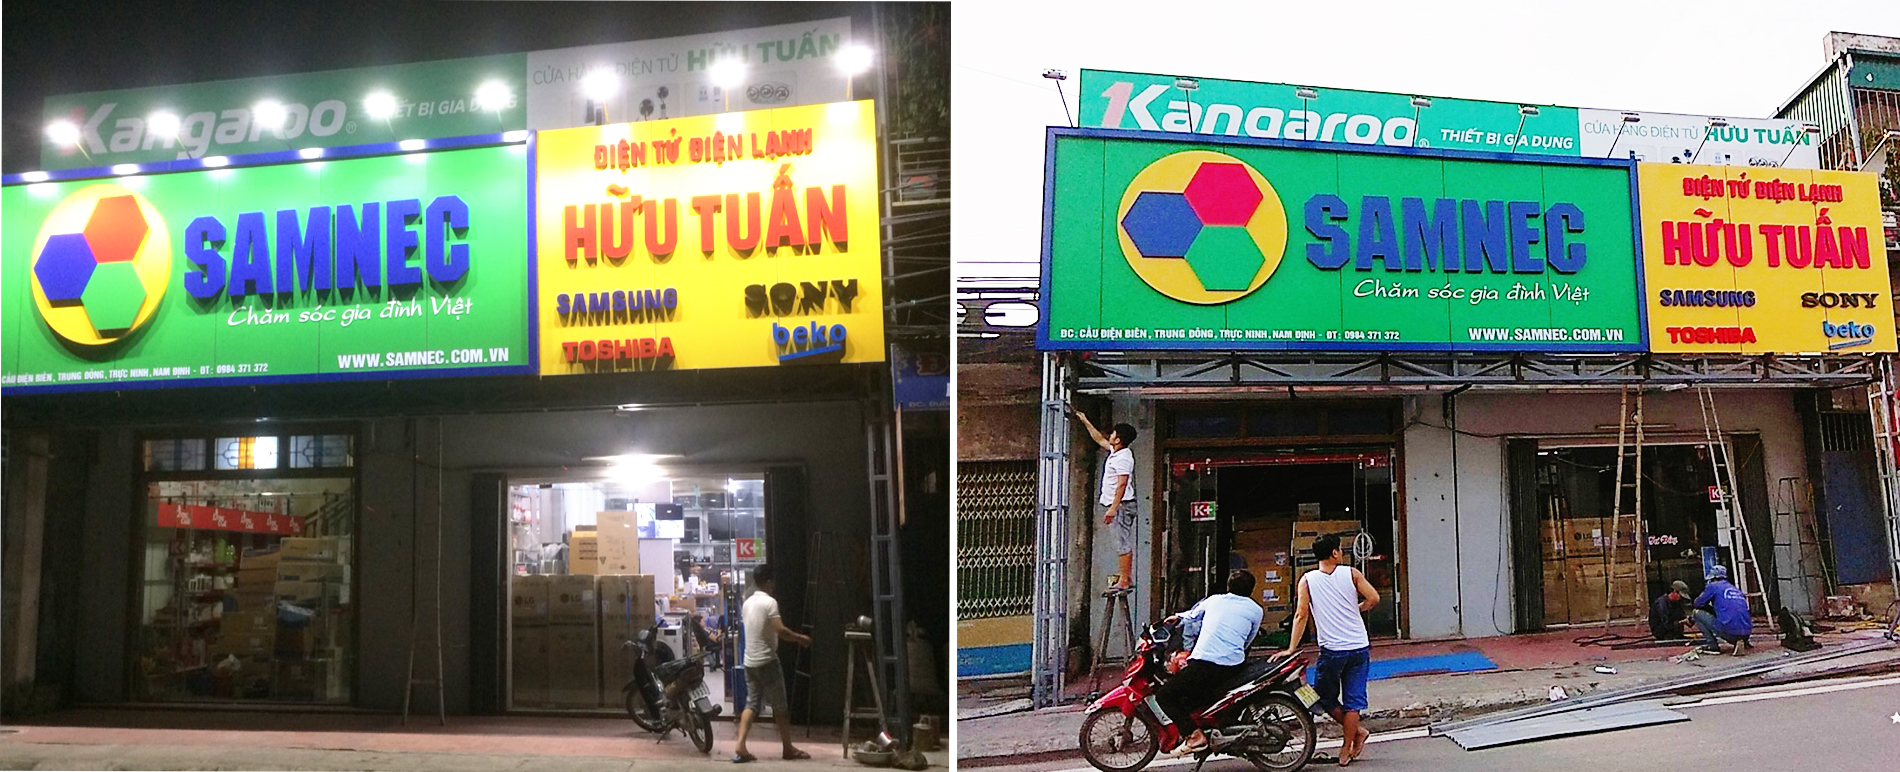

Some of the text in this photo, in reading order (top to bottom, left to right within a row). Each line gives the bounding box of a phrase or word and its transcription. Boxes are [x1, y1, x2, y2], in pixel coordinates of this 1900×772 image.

[657, 52, 680, 72] TỬ
[757, 28, 840, 63] TUẤN
[418, 102, 434, 118] BỊ
[438, 100, 465, 116] GIA
[1440, 127, 1484, 144] THIẾT
[1486, 132, 1501, 147] BỊ
[1532, 135, 1573, 150] DỤNG
[1584, 120, 1611, 134] CỬA
[1682, 125, 1699, 140] TỬ
[1753, 124, 1811, 145] TUẤN
[594, 128, 814, 172] ĐIỆN TỬ ĐIỆN LẠNH
[1682, 172, 1843, 205] ĐIỆN TỬ ĐIỆN LẠNH
[564, 164, 849, 264] HỮU TUẤN
[1304, 194, 1587, 274] SAMNEC
[1661, 207, 1871, 269] HỮU TUẤN
[184, 195, 470, 300] SAMNEC
[556, 288, 678, 319] SAMSUNG
[744, 279, 859, 316] SONY
[1353, 279, 1589, 305] Chăm sóc gia đình Việt
[1659, 289, 1756, 307] SAMSUNG
[1800, 292, 1879, 308] SONY
[227, 296, 473, 327] Chăm sóc gia đình Việt
[772, 320, 847, 347] beko
[1154, 329, 1185, 338] TRUNG
[1273, 330, 1292, 339] NAM
[1295, 330, 1315, 342] ĐỊNH
[1344, 330, 1365, 340] 0984
[1367, 331, 1381, 340] 371
[1383, 331, 1400, 340] 372
[1469, 328, 1623, 341] WWW.SAMNEC.COM.VN
[1666, 326, 1757, 344] TOSHIBA
[1822, 320, 1875, 338] beko
[337, 347, 509, 369] WWW.SAMNEC.COM.VN
[562, 337, 676, 364] TOSHIBA
[58, 371, 82, 381] TRUNG
[153, 366, 170, 376] NAM
[216, 364, 235, 374] 0984
[238, 363, 251, 373] 371
[254, 363, 268, 372] 372
[1194, 505, 1213, 517] K+
